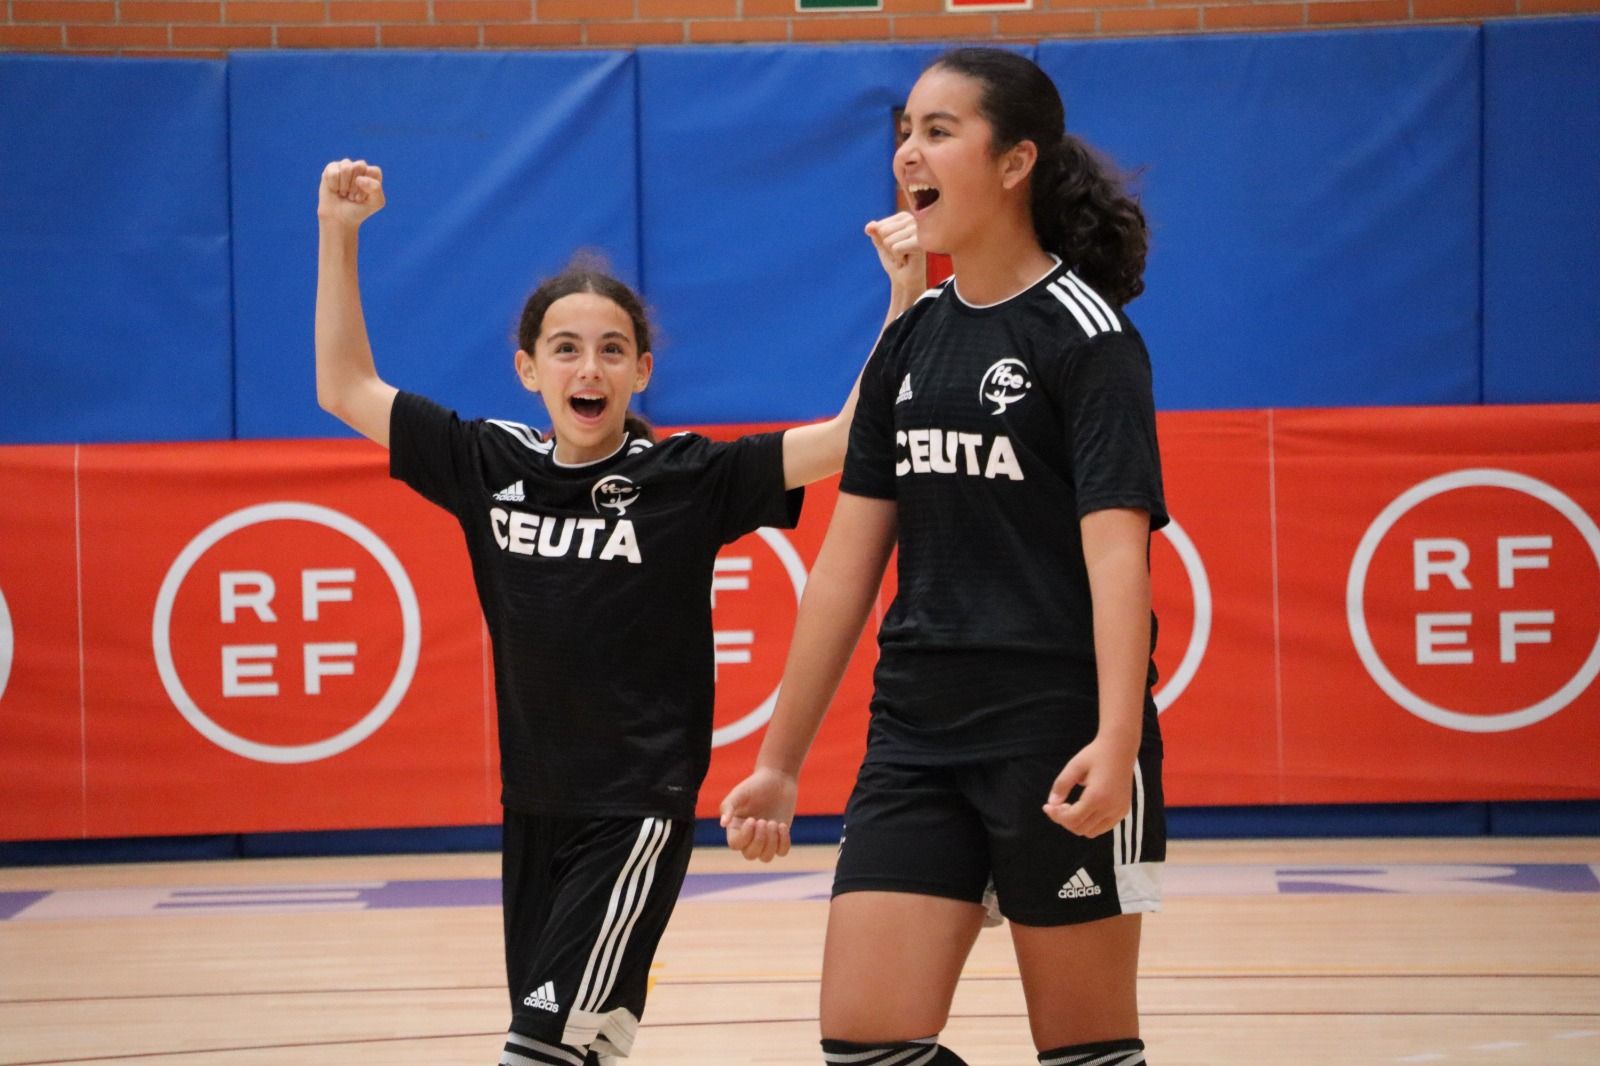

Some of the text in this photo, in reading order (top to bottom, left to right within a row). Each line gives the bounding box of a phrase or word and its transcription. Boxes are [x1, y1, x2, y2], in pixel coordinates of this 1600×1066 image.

[896, 429, 1024, 481] CEUTA
[490, 507, 642, 564] CEUTA
[1058, 885, 1101, 898] adidas
[523, 996, 559, 1013] adidas
